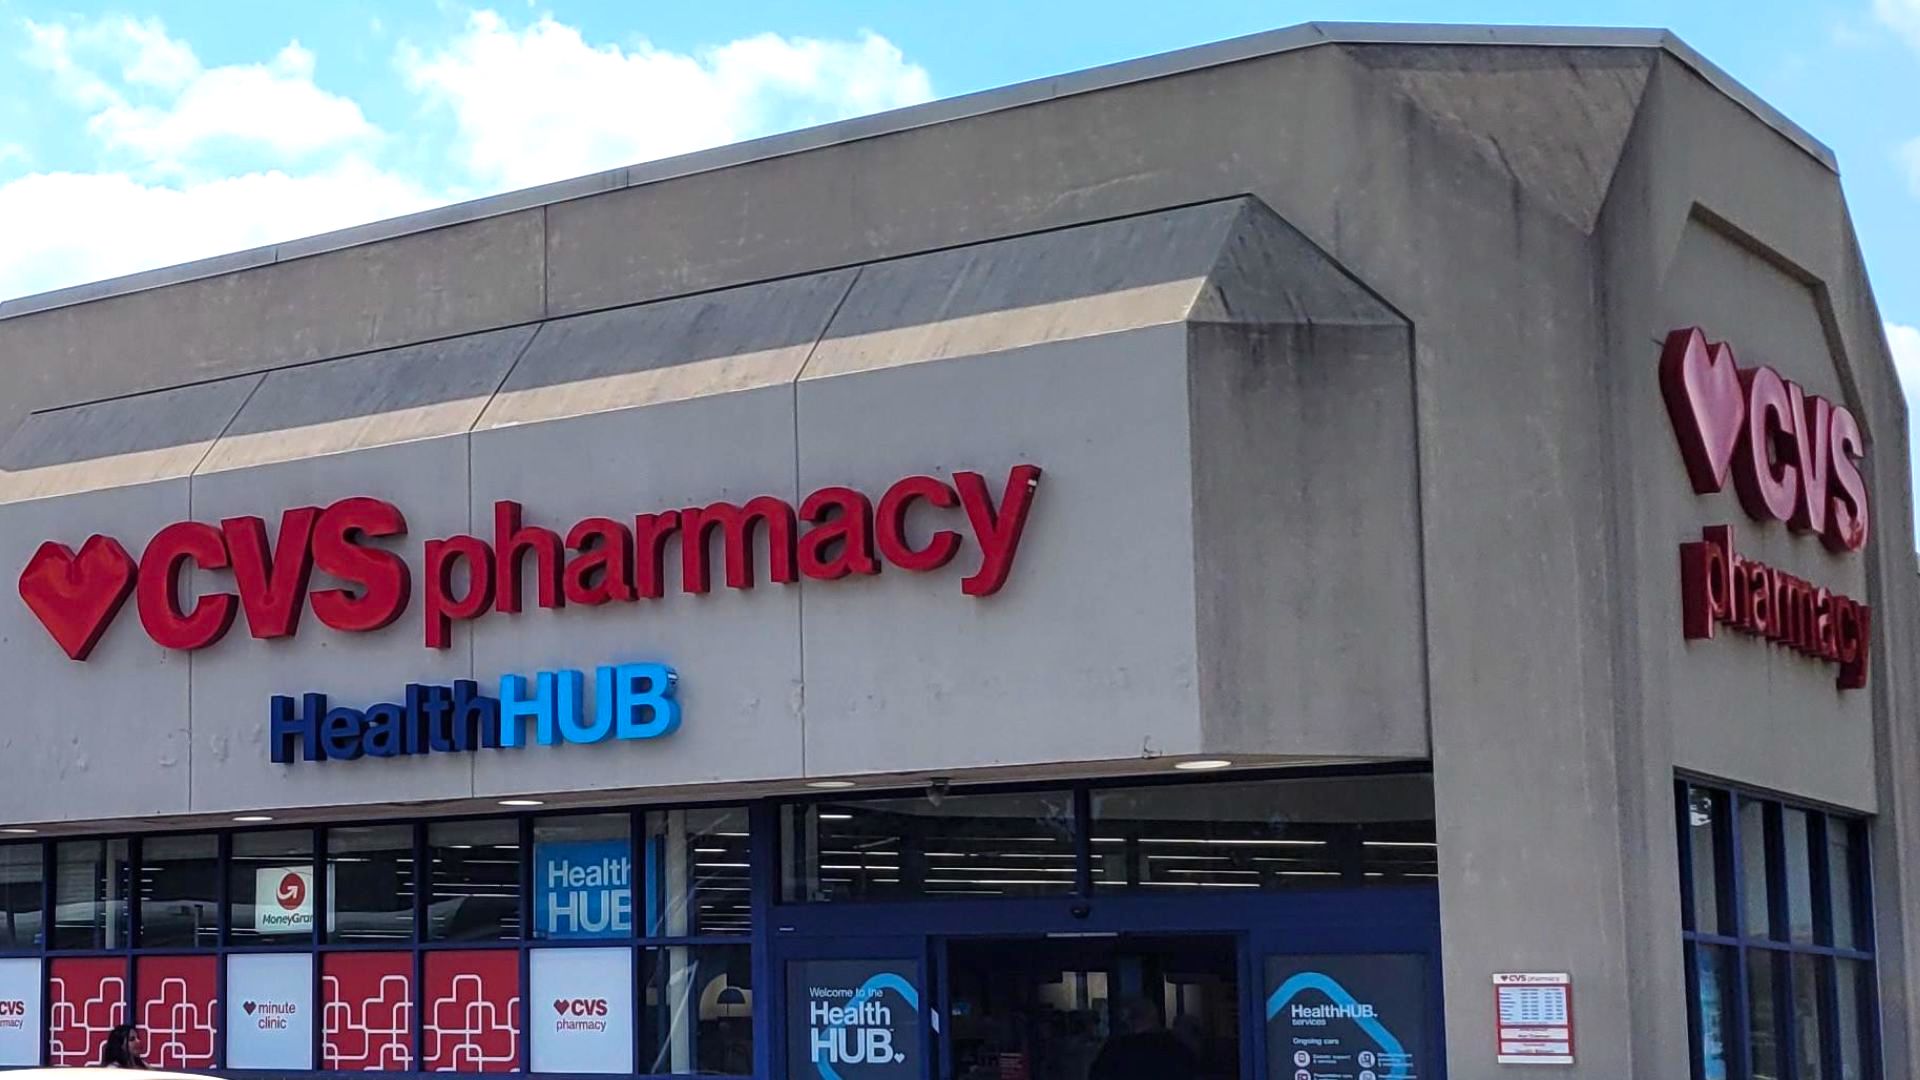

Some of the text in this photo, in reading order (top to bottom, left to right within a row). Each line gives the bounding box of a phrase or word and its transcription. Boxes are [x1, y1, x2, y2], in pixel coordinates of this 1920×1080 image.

[1731, 366, 1869, 553] CVS
[137, 464, 1042, 650] CVS pharmacy
[1680, 525, 1871, 689] pharmacy
[271, 662, 681, 763] HealthHUB
[809, 987, 883, 998] Welcome to the
[0, 1001, 24, 1015] CVS
[258, 1001, 296, 1014] minute
[571, 999, 608, 1016] CVS
[810, 1001, 891, 1025] Health
[258, 1016, 287, 1029] clinic
[557, 1019, 607, 1032] pharmacy
[1292, 1018, 1327, 1026] services
